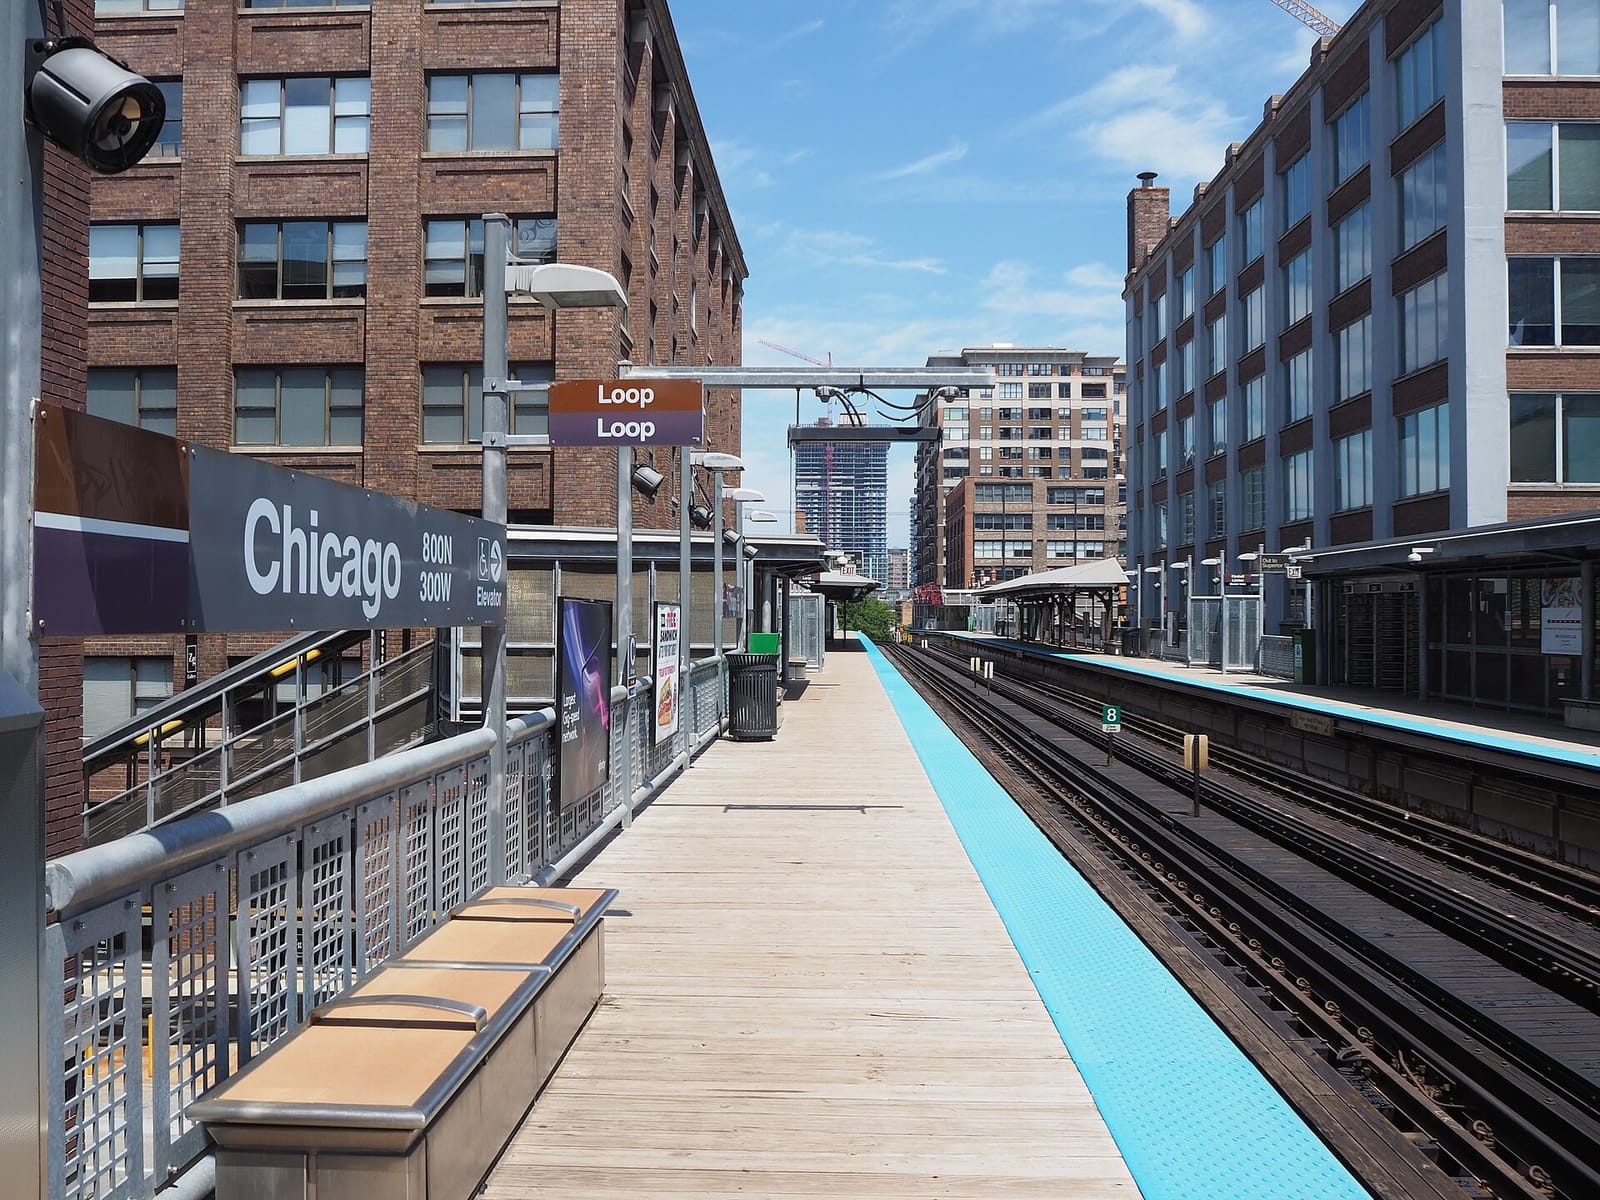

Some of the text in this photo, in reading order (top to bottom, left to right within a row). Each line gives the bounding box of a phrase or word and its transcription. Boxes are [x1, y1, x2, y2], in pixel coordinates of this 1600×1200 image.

[598, 384, 655, 408] Loop
[597, 418, 656, 442] Loop
[244, 497, 402, 619] Chicago
[422, 531, 453, 565] 800N
[842, 566, 855, 575] EXIT
[419, 571, 452, 602] 300W
[476, 586, 502, 607] Elevator
[1106, 708, 1117, 722] 8
